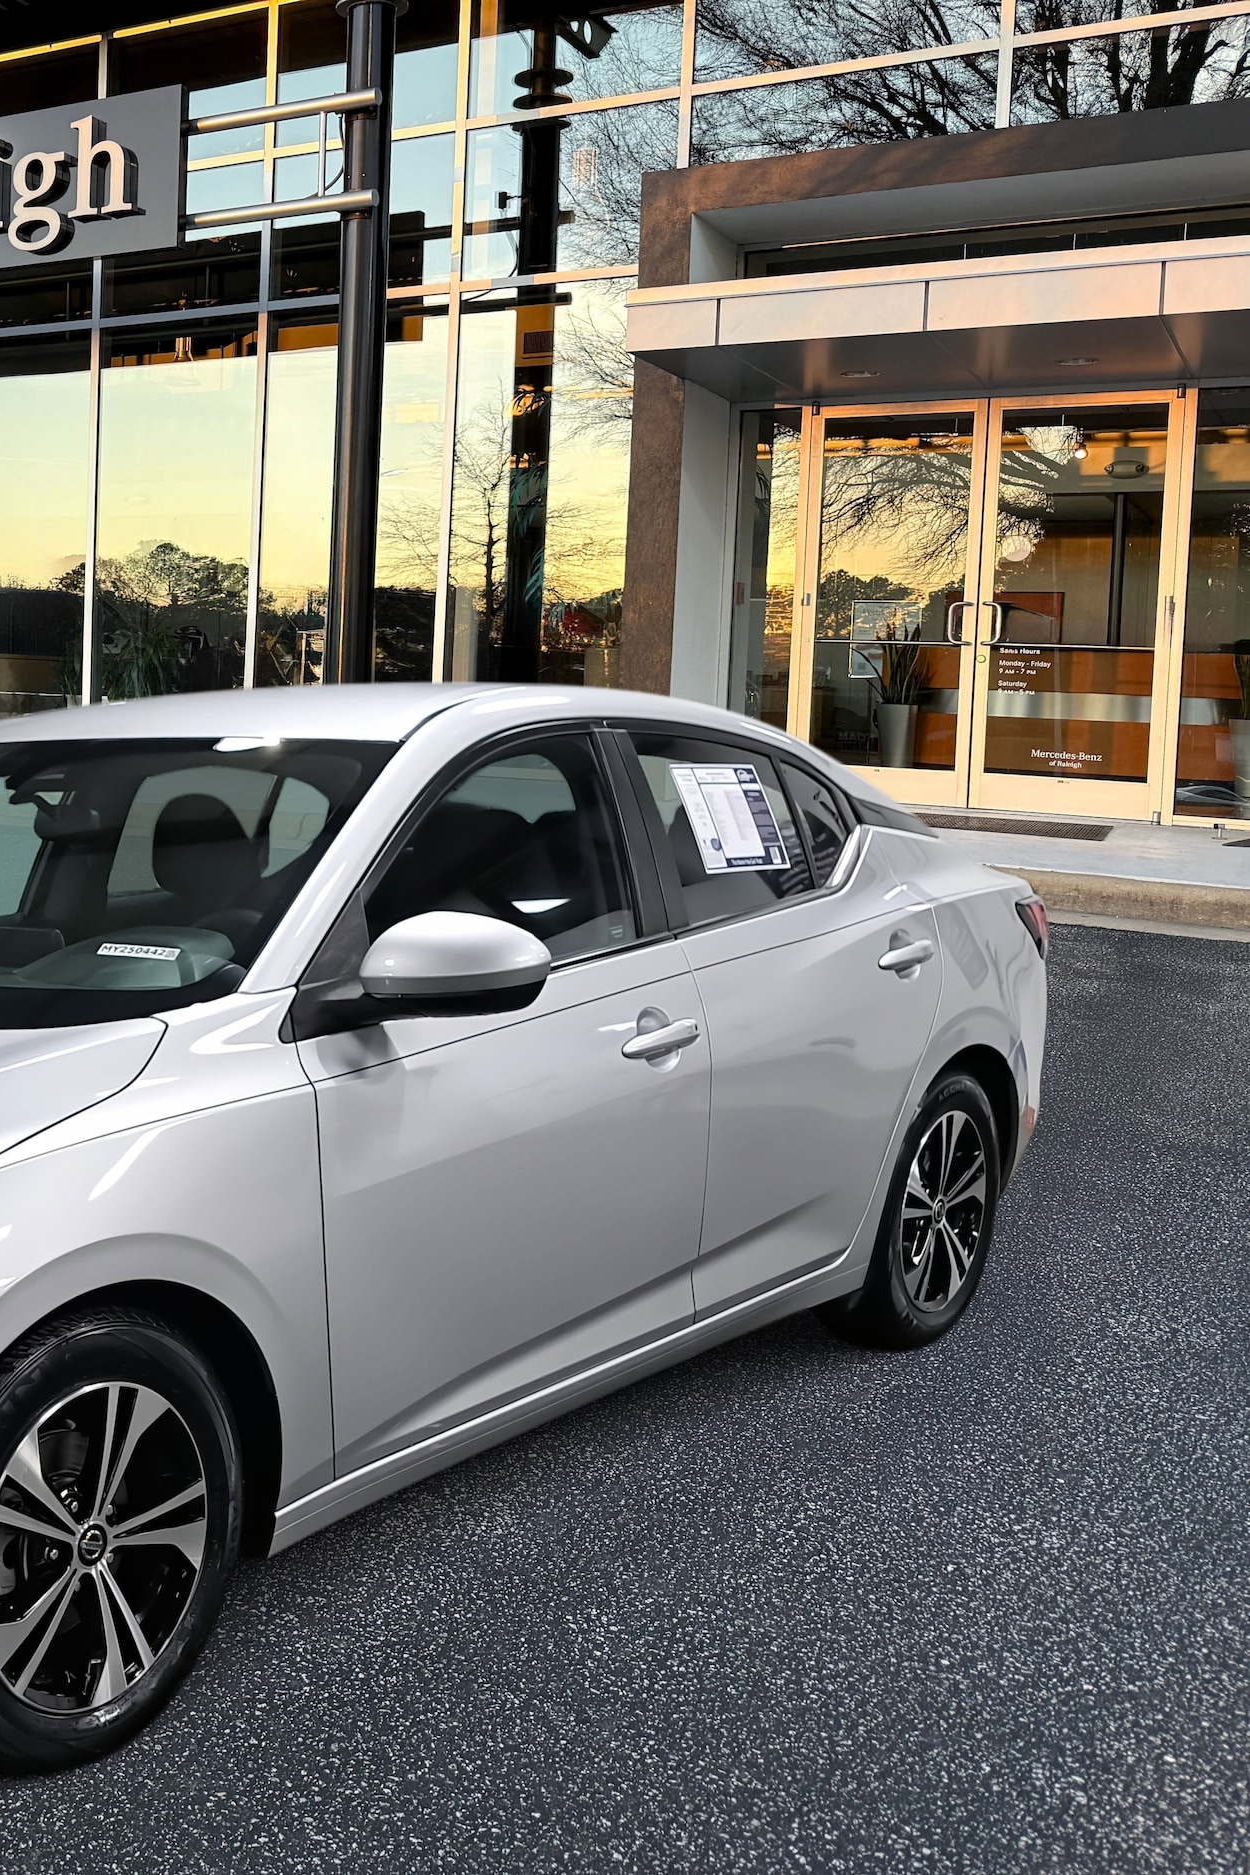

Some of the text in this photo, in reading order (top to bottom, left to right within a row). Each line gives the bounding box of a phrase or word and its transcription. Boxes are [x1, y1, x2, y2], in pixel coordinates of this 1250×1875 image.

[999, 660, 1025, 668] Monday
[1030, 661, 1051, 669] Friday
[998, 680, 1028, 688] Saturday
[1031, 749, 1103, 762] Mercedes-Benz
[1057, 761, 1082, 769] Raleigh
[101, 945, 167, 956] MY250442
